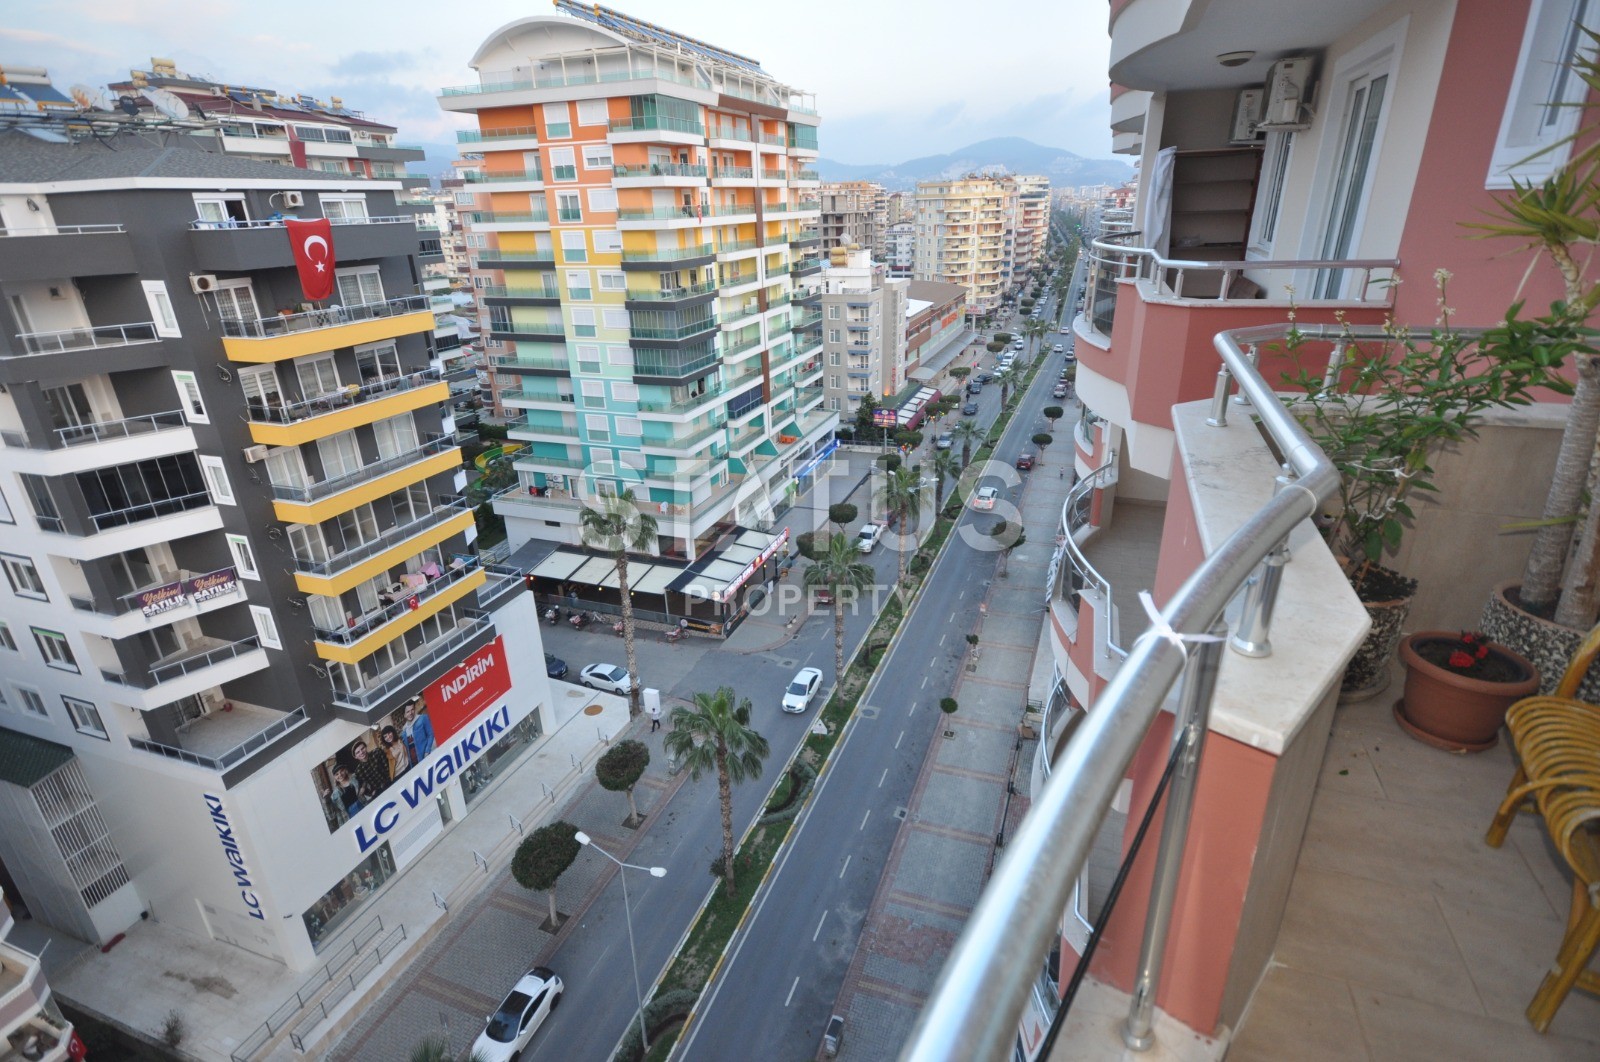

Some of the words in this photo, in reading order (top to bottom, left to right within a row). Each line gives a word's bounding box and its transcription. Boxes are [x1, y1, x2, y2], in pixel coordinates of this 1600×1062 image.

[142, 593, 187, 615] SATILIK
[193, 580, 236, 600] SATILIK
[440, 653, 495, 703] İNDİRİM
[354, 801, 400, 853] LC
[241, 890, 264, 920] LC
